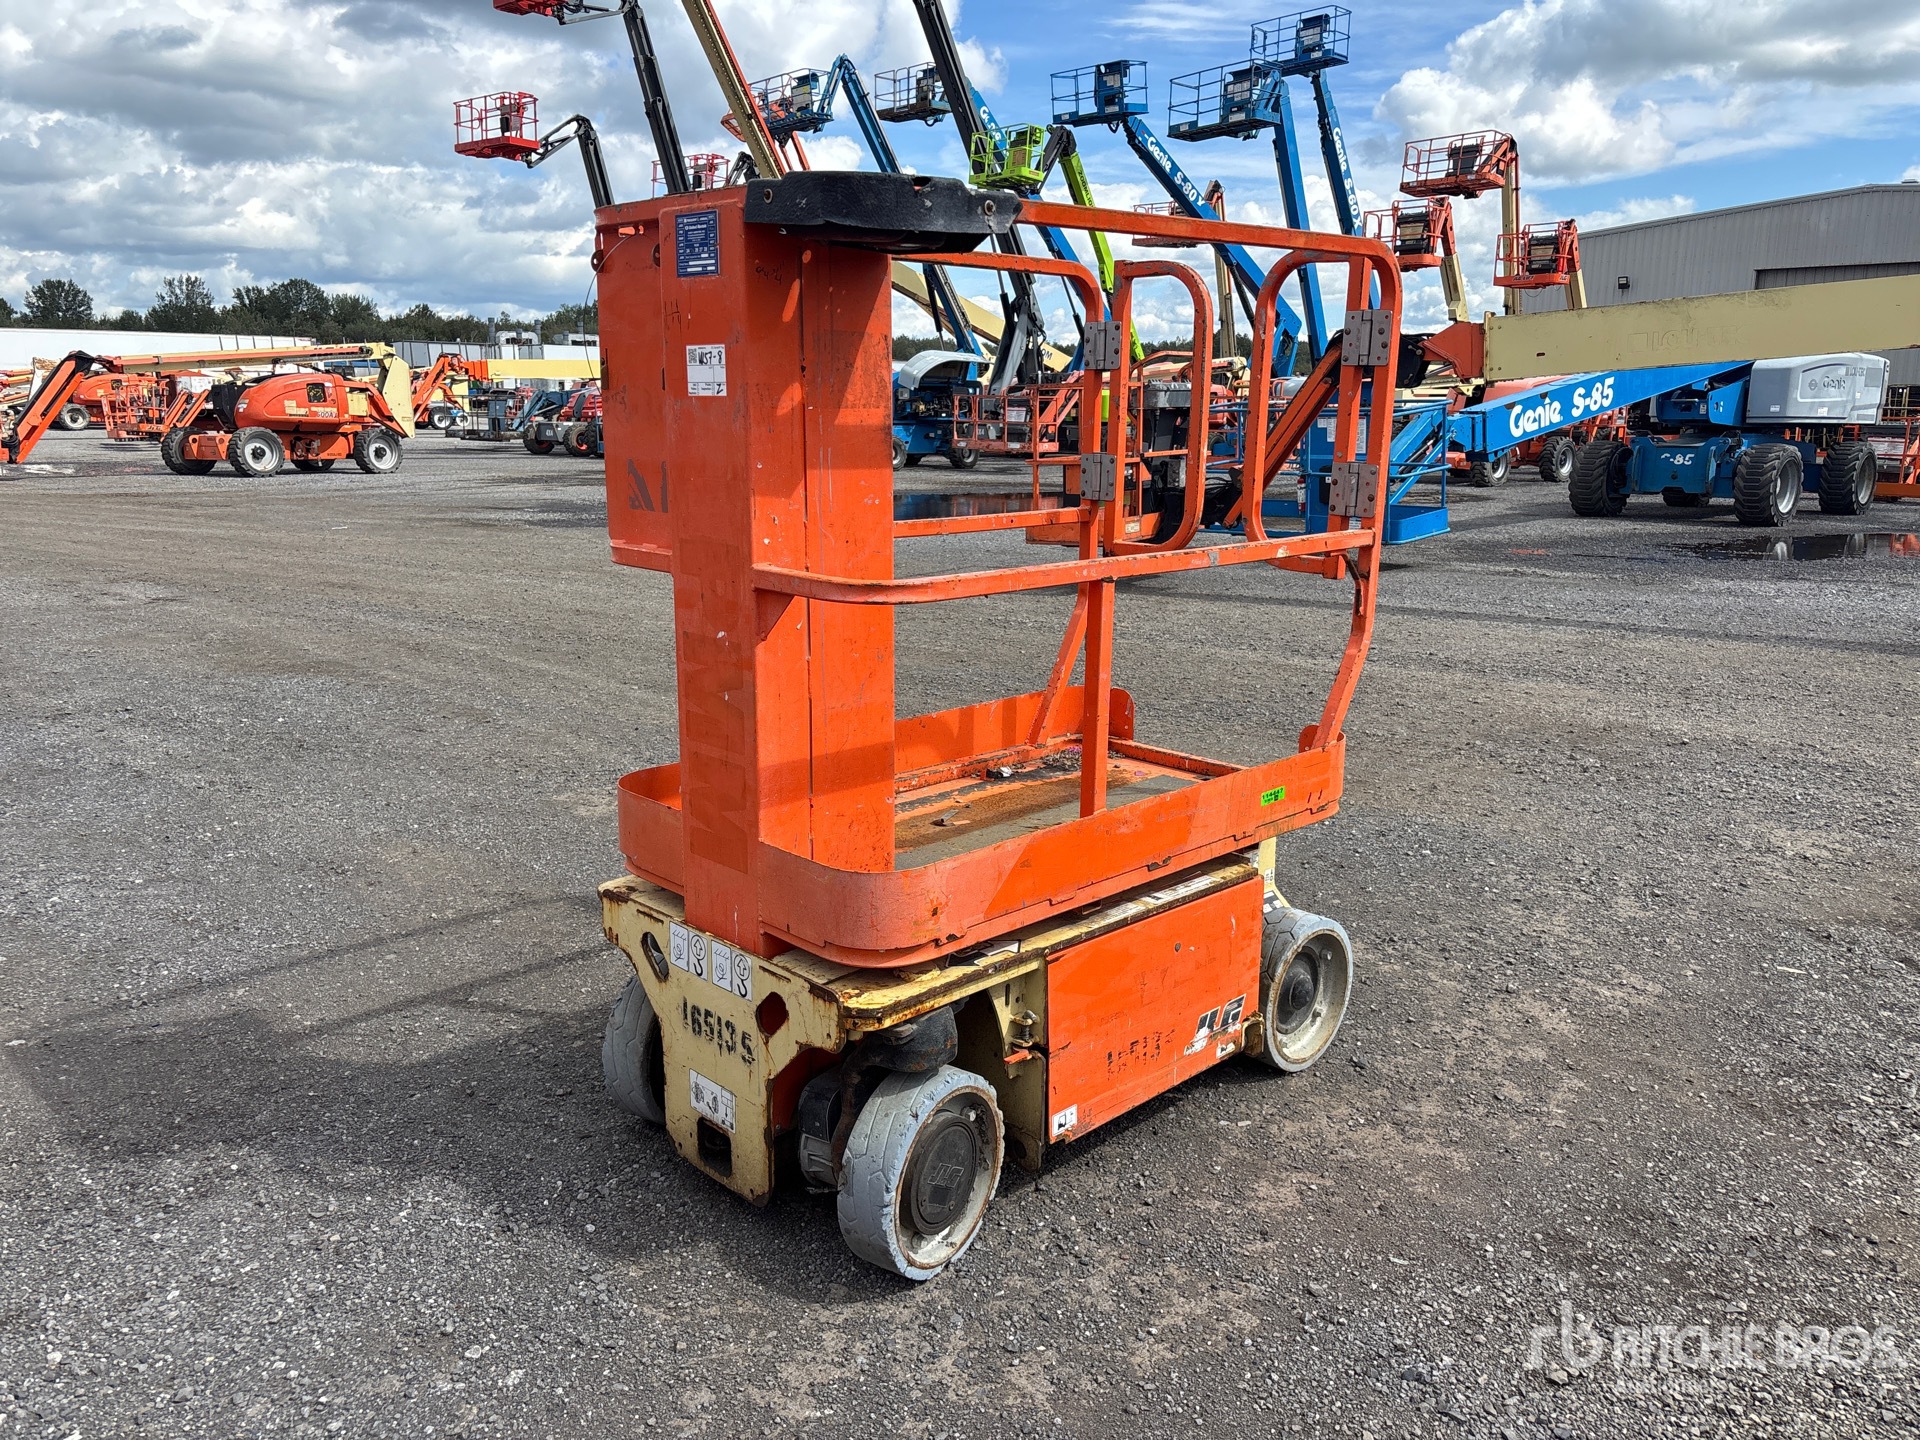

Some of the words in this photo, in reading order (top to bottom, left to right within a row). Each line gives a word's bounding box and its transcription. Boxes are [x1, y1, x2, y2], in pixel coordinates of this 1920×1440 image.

[1147, 136, 1172, 172] Genie
[1333, 127, 1348, 173] Genie
[1078, 170, 1094, 207] ZOOMLIO
[1509, 397, 1562, 438] Genie
[1571, 377, 1615, 418] S-85
[682, 995, 756, 1066] 165135
